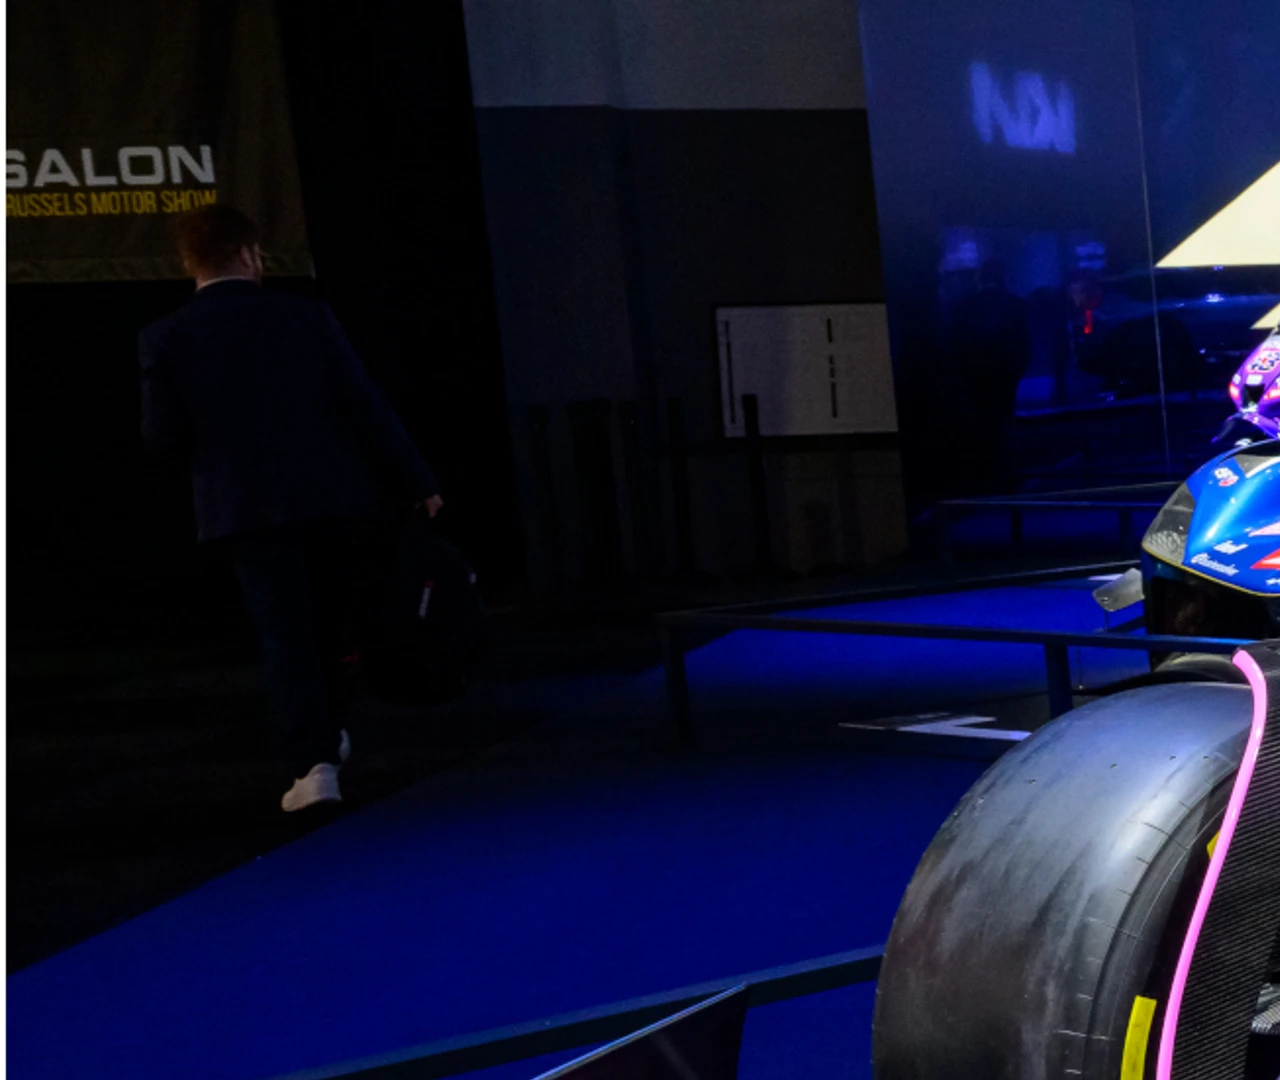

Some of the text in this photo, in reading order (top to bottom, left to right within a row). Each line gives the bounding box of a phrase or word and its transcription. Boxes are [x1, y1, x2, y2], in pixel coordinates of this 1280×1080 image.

[6, 144, 216, 189] SALON
[6, 190, 88, 217] RUSSELS
[89, 189, 159, 215] MOTOR
